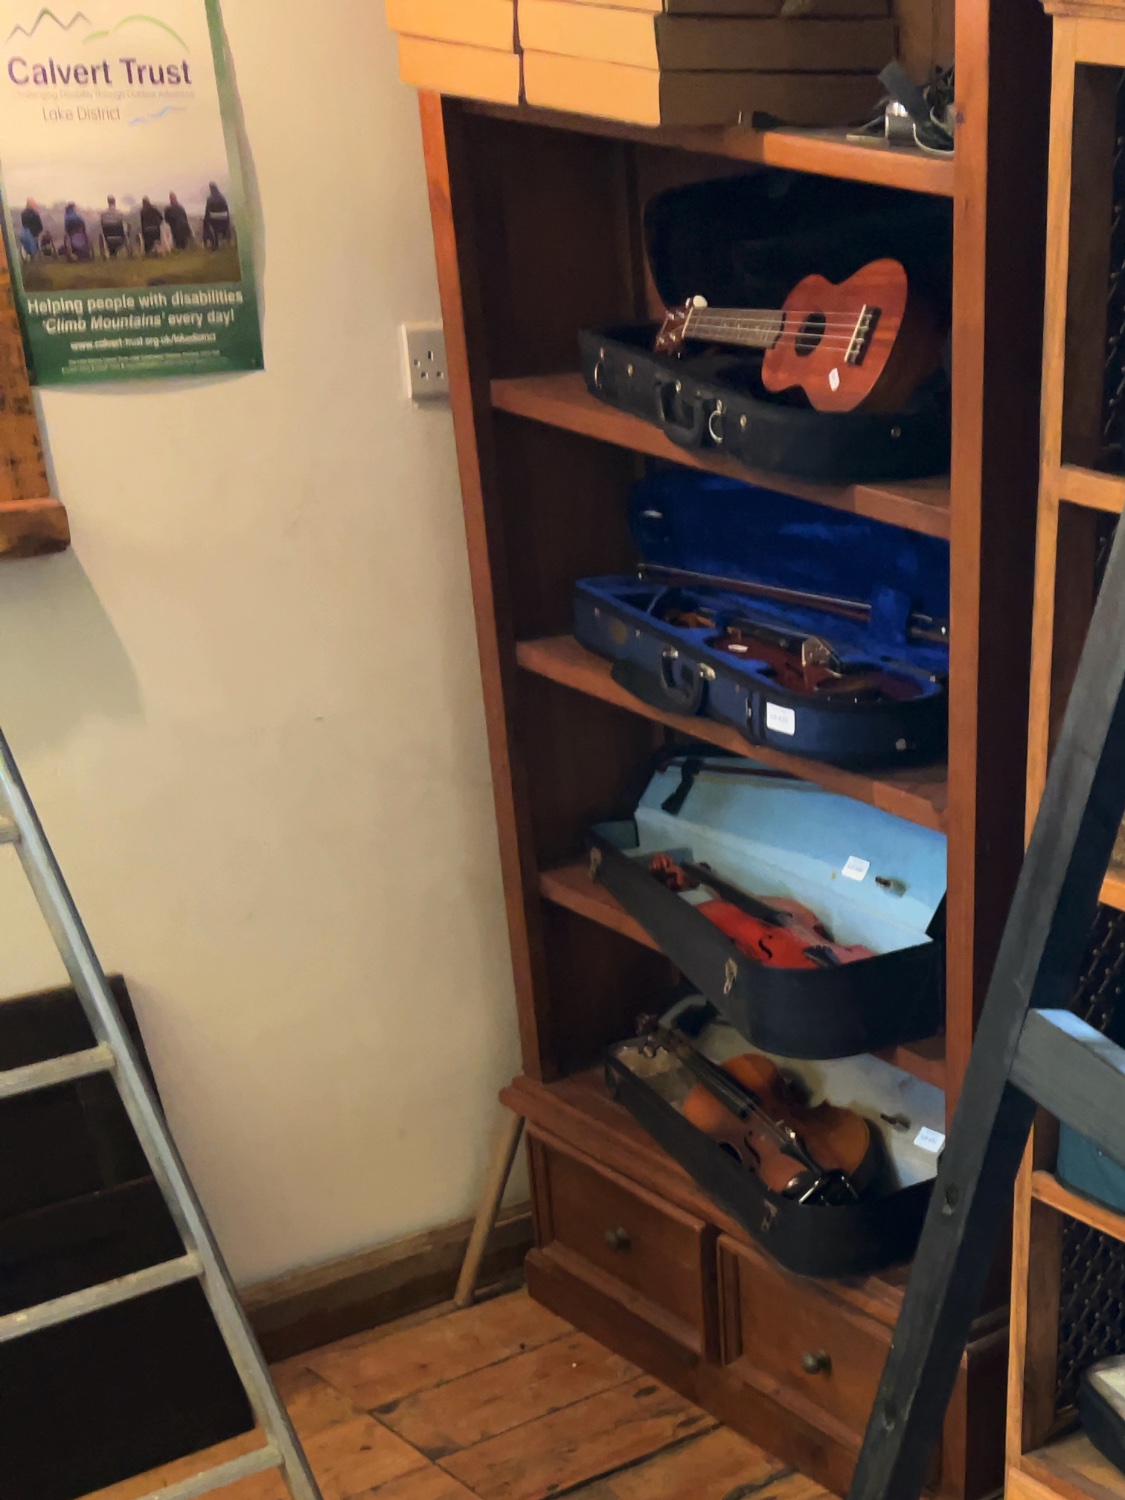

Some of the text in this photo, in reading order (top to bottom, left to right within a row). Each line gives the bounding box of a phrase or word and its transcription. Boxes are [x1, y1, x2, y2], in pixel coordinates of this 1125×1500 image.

[8, 55, 192, 86] Calvert Trust
[43, 105, 121, 122] Lake District
[28, 289, 243, 315] Helping people with disabilities
[168, 311, 203, 328] every
[207, 308, 235, 327] day!
